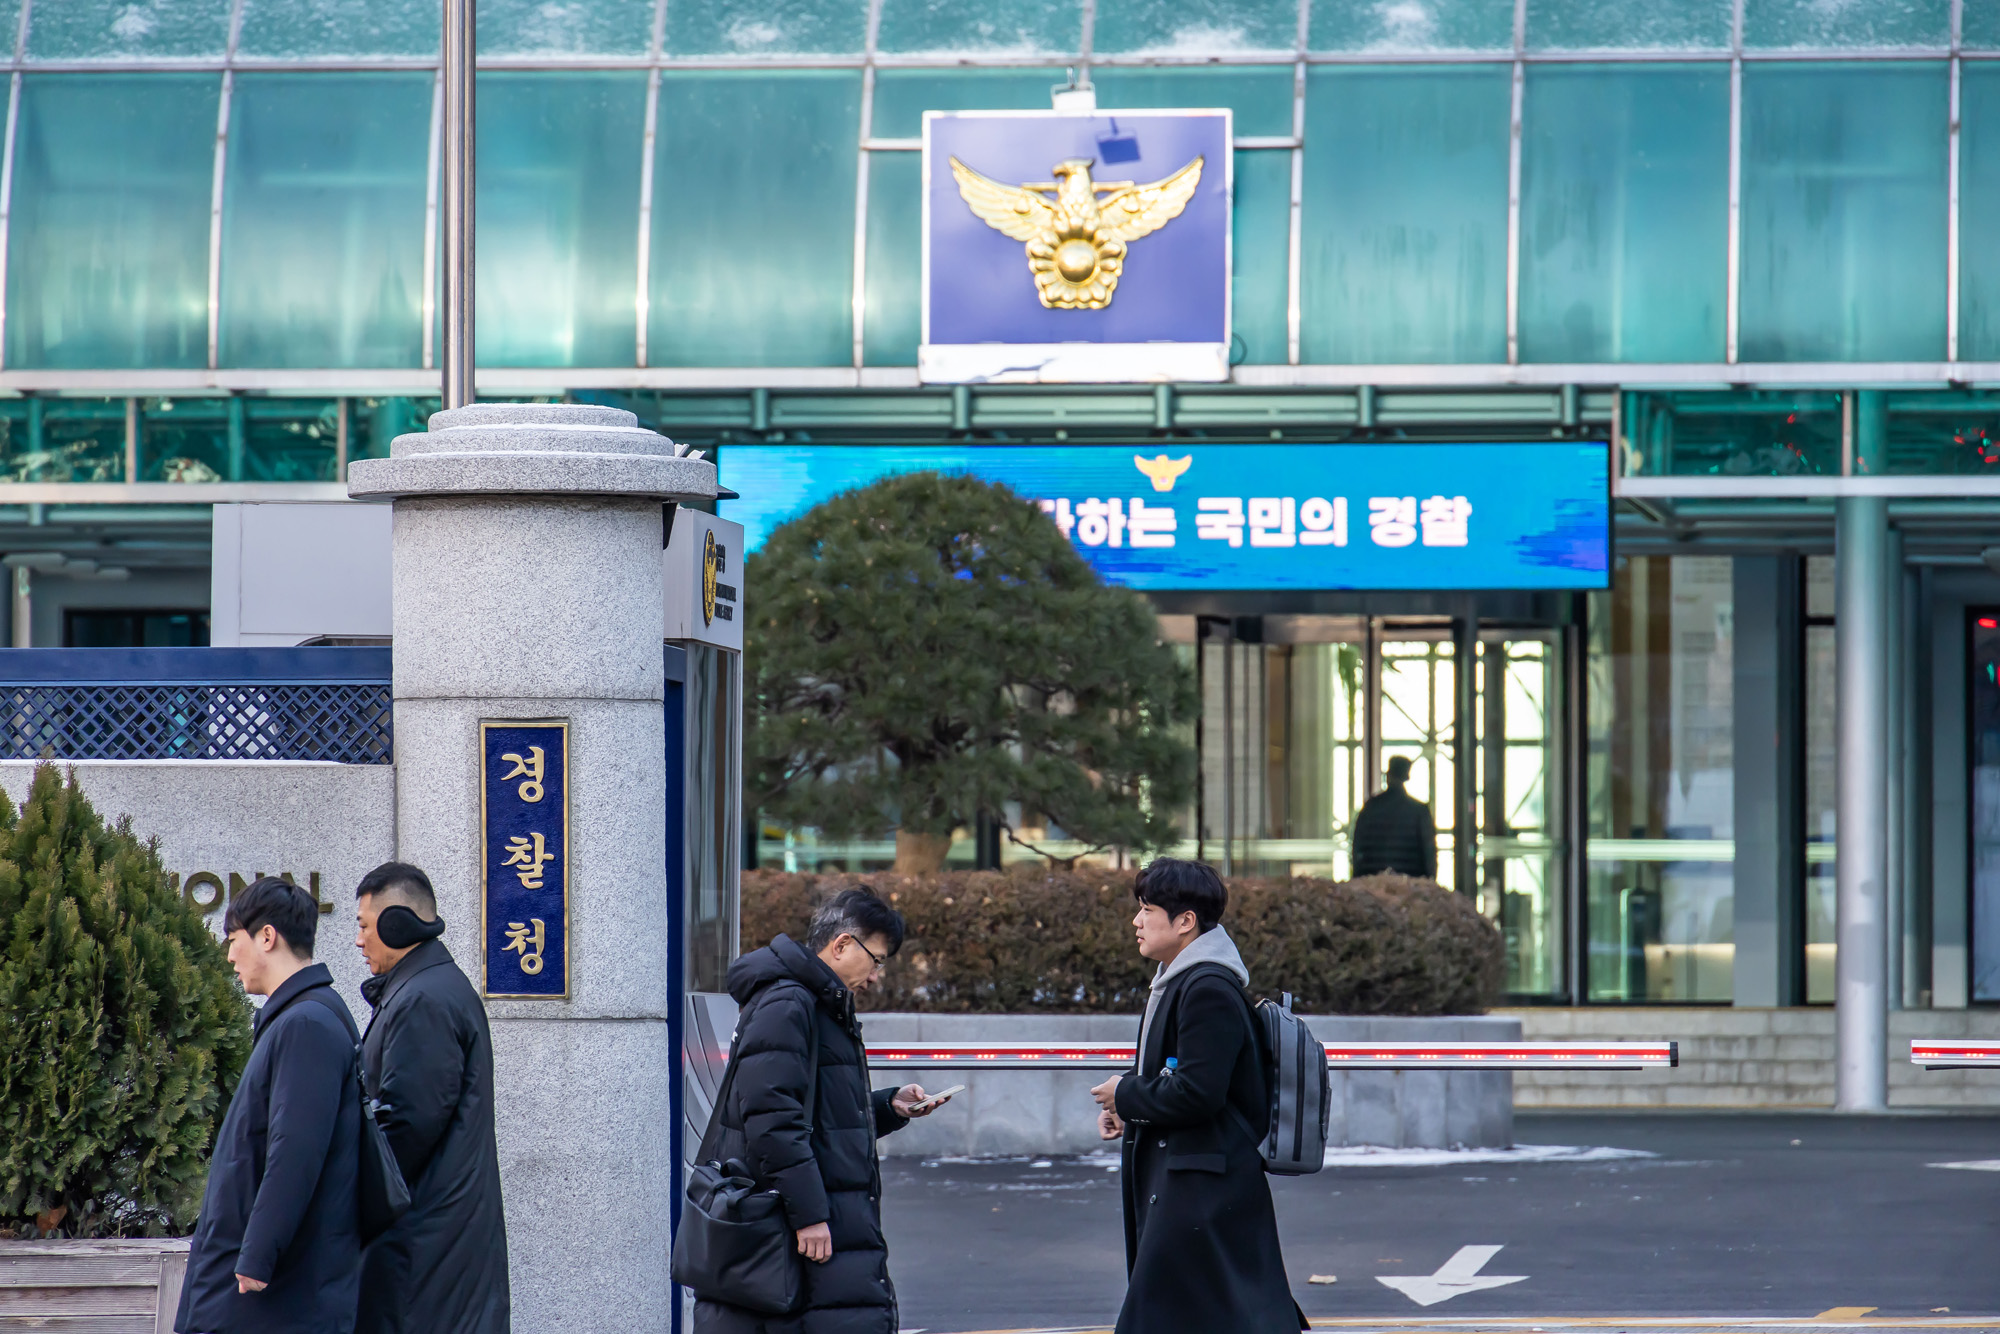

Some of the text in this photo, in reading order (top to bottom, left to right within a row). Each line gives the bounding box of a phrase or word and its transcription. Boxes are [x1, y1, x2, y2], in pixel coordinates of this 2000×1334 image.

[1195, 496, 1348, 548] 국민의
[1368, 495, 1473, 548] 경찰
[501, 746, 555, 975] 경찰청
